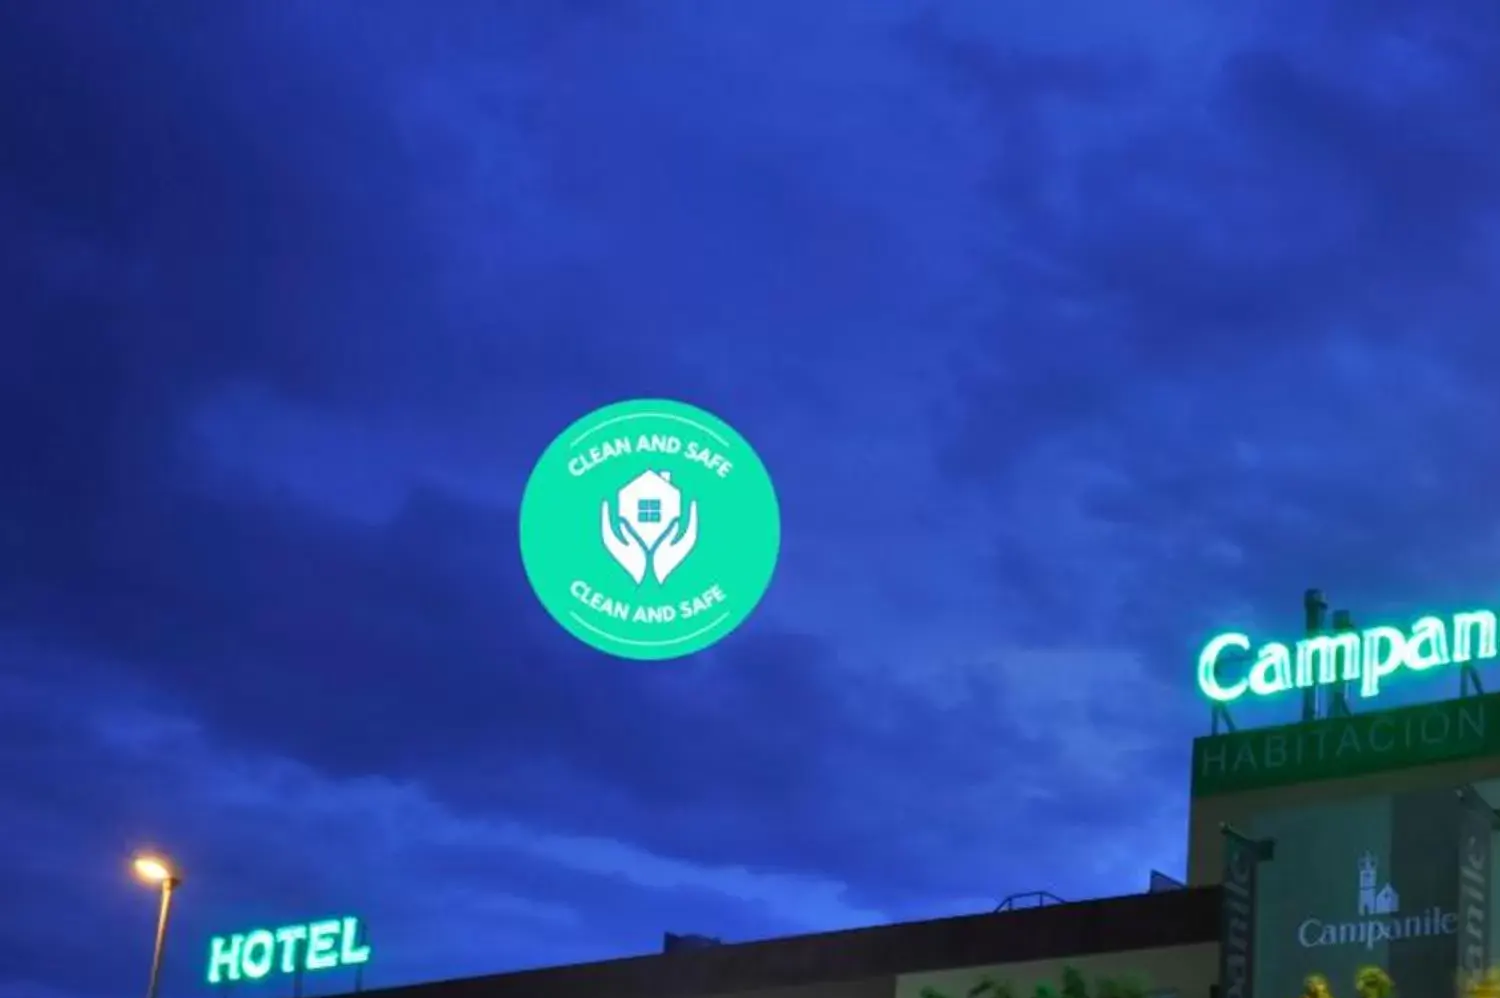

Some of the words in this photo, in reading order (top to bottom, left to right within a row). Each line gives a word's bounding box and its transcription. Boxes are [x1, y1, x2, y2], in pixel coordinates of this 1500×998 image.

[1298, 907, 1458, 950] Campanile
[1458, 835, 1487, 975] anile
[208, 917, 370, 983] HOTEL
